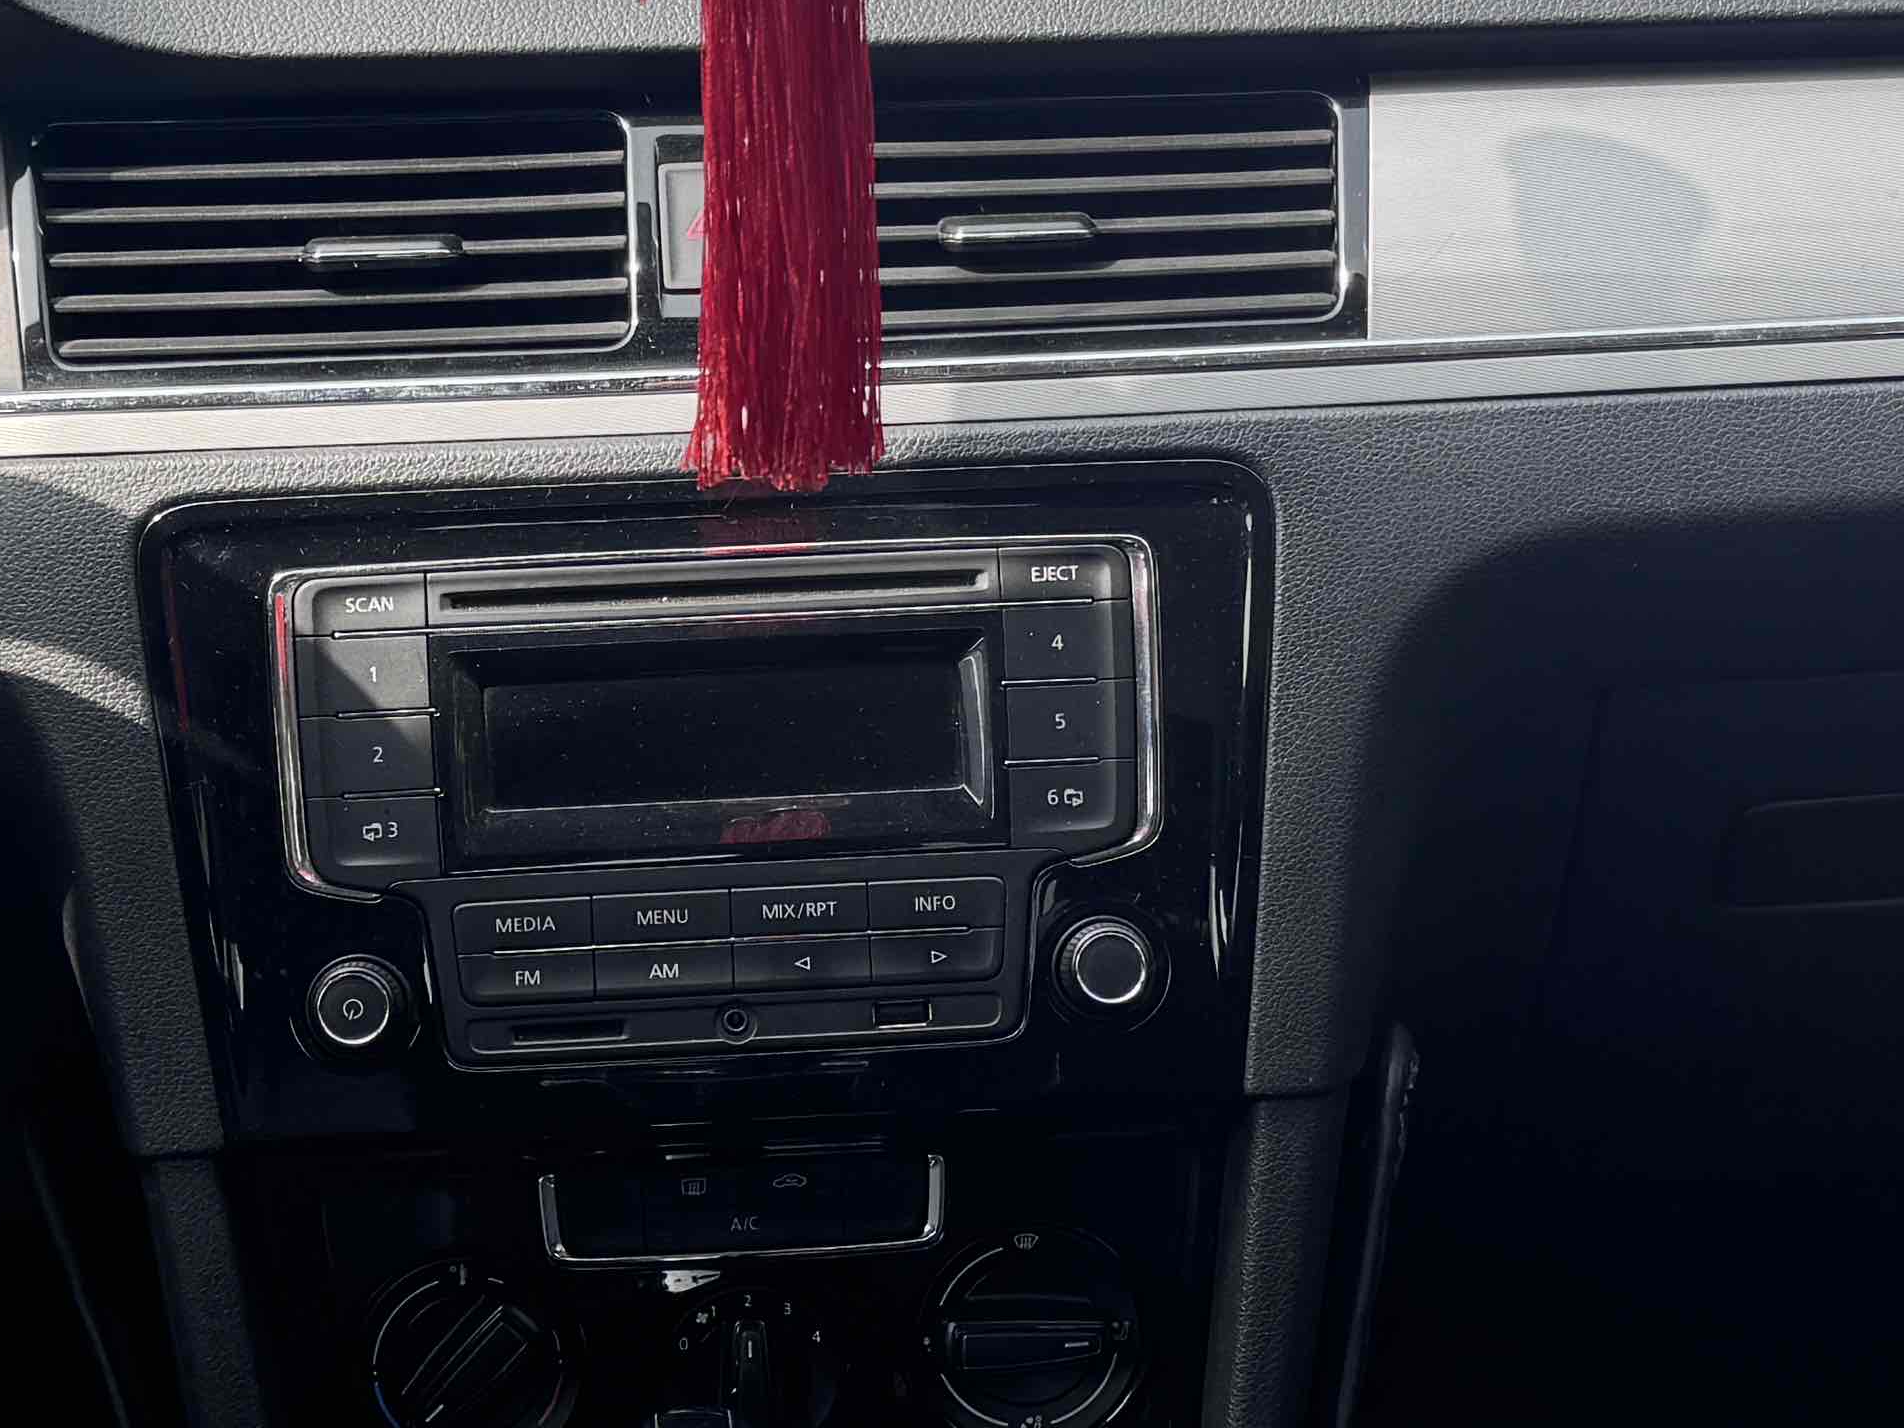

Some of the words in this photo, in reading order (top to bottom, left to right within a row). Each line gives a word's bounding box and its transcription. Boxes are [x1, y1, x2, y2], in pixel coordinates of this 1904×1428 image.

[1029, 564, 1079, 584] EJECT
[344, 595, 395, 614] SCAN
[1050, 634, 1065, 651] 4
[368, 666, 379, 683] 1
[1054, 713, 1067, 730] 5
[372, 745, 384, 763] 2
[1046, 788, 1060, 805] 6
[386, 821, 399, 838] 3
[495, 913, 557, 935] MEDIA
[636, 907, 690, 927] MENU
[761, 899, 838, 921] MIX/RPT
[913, 893, 957, 913] INFO
[514, 969, 541, 987] FM
[649, 961, 680, 980] AM
[730, 1216, 760, 1233] A/C
